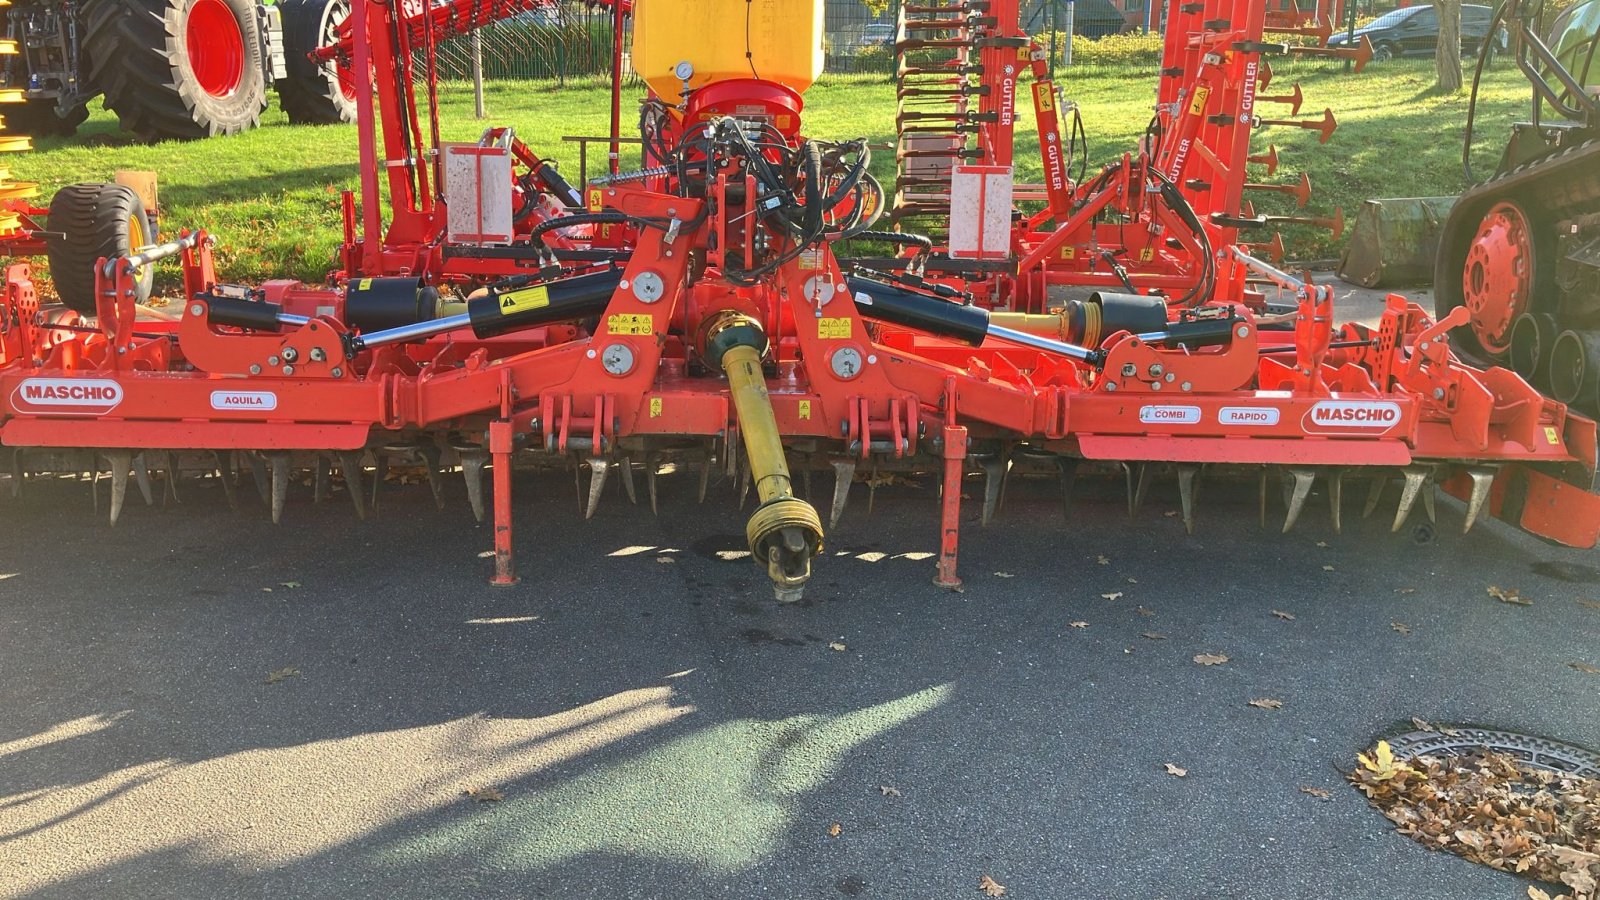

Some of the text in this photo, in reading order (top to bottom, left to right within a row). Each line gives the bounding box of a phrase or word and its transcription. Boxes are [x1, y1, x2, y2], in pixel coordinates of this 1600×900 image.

[25, 385, 116, 400] MASCHIO
[224, 396, 263, 405] AQUILA
[1154, 411, 1186, 419] COMBI
[1231, 412, 1268, 421] RAPIDO
[1315, 408, 1396, 422] MASCHIO
